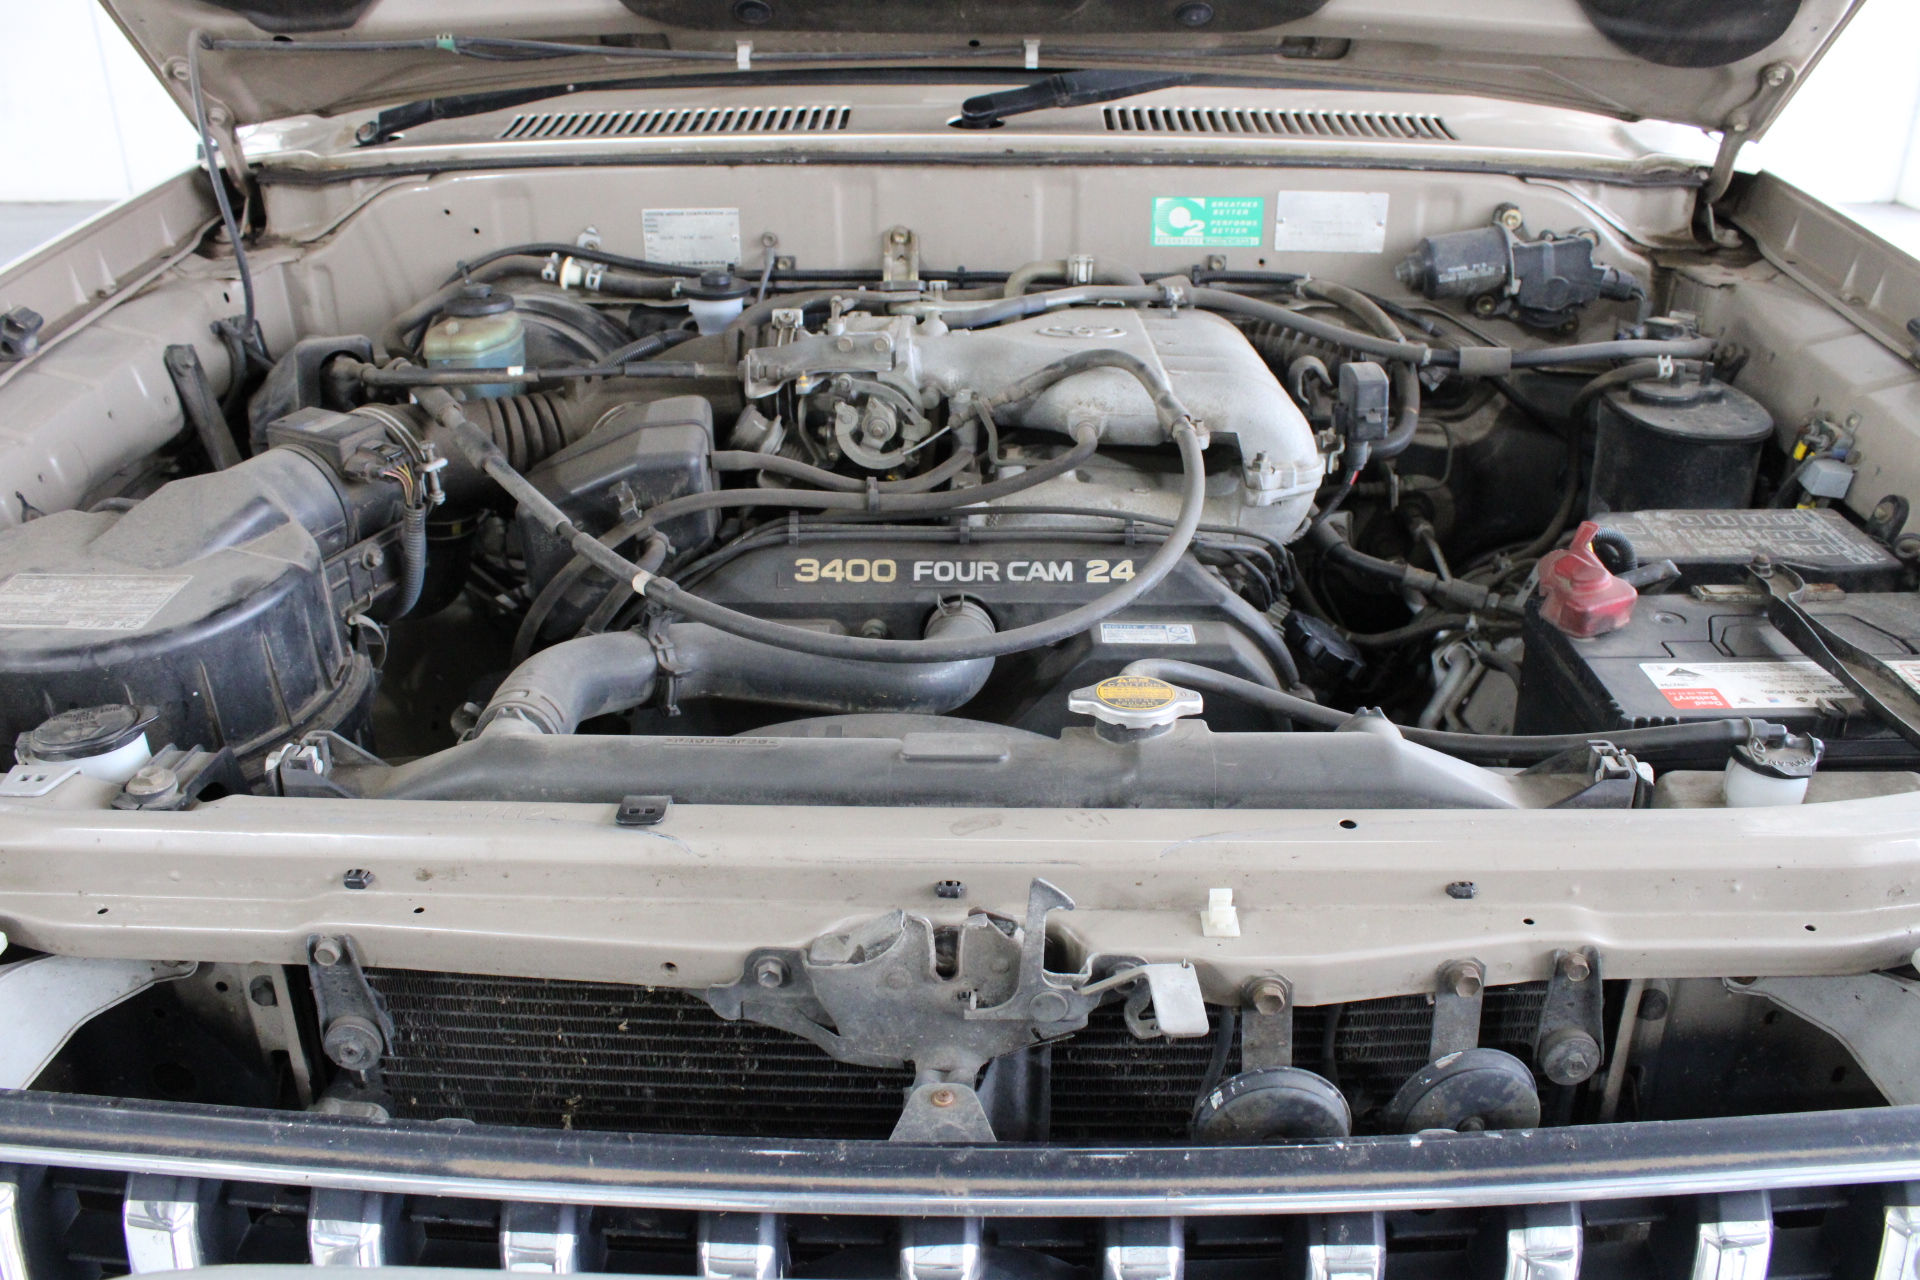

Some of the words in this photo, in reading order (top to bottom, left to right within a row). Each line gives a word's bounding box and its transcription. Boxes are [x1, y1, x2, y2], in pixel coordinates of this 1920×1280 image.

[1209, 219, 1258, 227] PERFORMS
[794, 558, 898, 583] 3400
[913, 560, 1001, 582] FOUR
[1006, 560, 1074, 582] CAM
[1085, 559, 1136, 583] 24
[1673, 694, 1719, 702] Battery?
